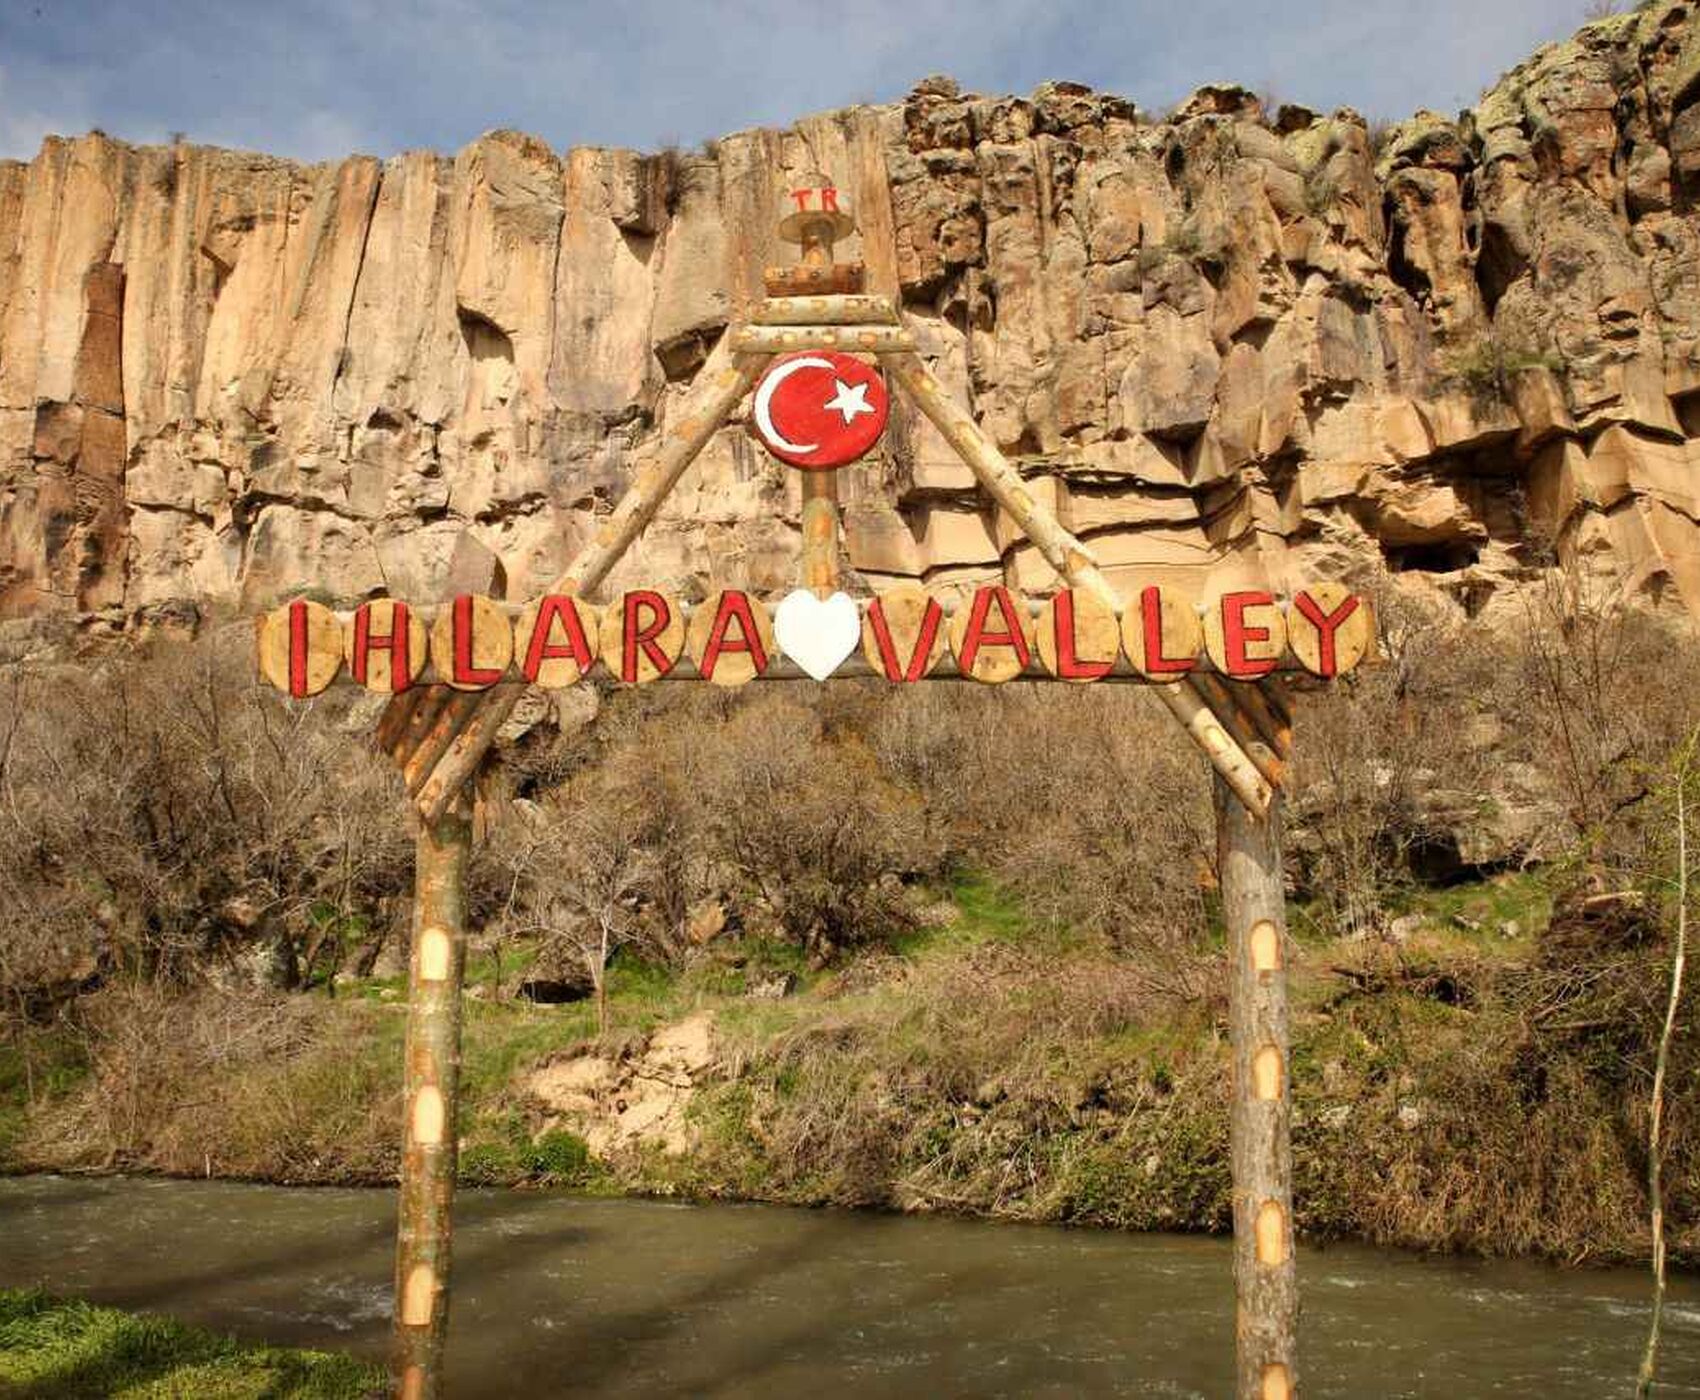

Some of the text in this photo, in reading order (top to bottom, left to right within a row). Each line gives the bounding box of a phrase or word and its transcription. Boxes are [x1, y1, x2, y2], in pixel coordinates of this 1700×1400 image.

[791, 187, 840, 212] TR
[288, 585, 1362, 699] IHLARA VALLEY
